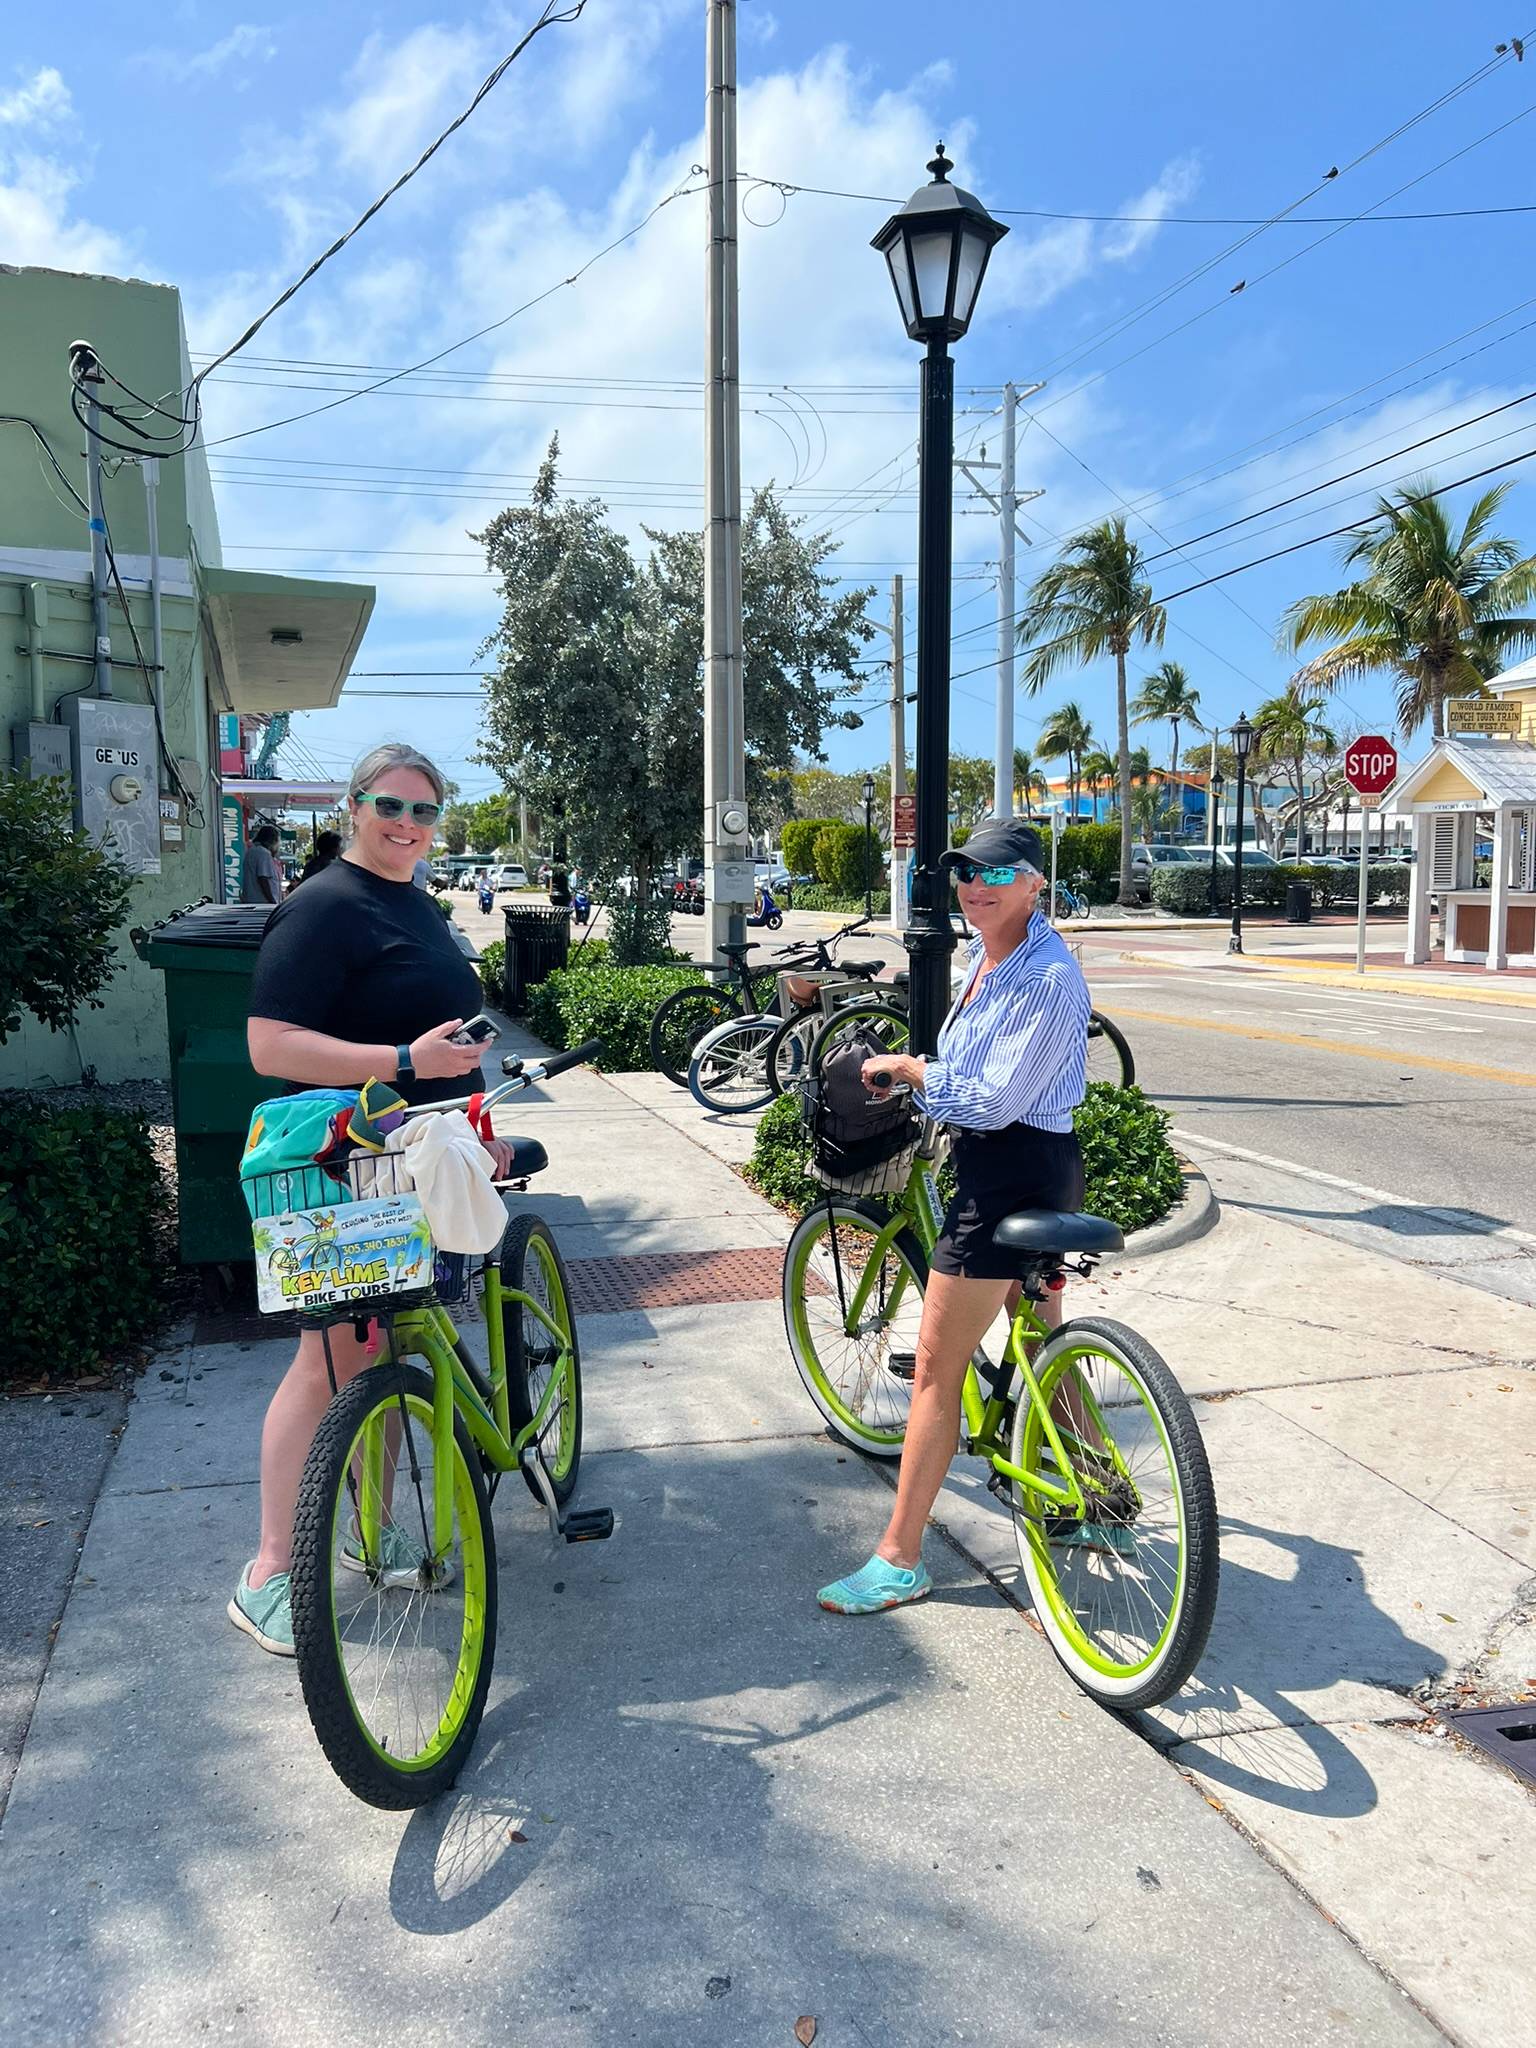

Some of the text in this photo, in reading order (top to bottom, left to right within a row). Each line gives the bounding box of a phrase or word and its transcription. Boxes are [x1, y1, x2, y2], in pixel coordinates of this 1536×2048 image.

[1450, 712, 1520, 722] CONCH TOUR TRAIN
[1457, 702, 1515, 712] WORLD FAMOUS
[1461, 722, 1477, 730] KEY
[1348, 753, 1395, 777] STOP
[341, 1216, 369, 1230] CRUISING
[382, 1210, 397, 1218] BEST
[373, 1220, 385, 1229] OLD
[385, 1217, 397, 1225] KEY
[342, 1235, 408, 1256] 305.340.7834
[281, 1270, 326, 1296] KEY
[304, 1282, 391, 1306] BIKE TOURS
